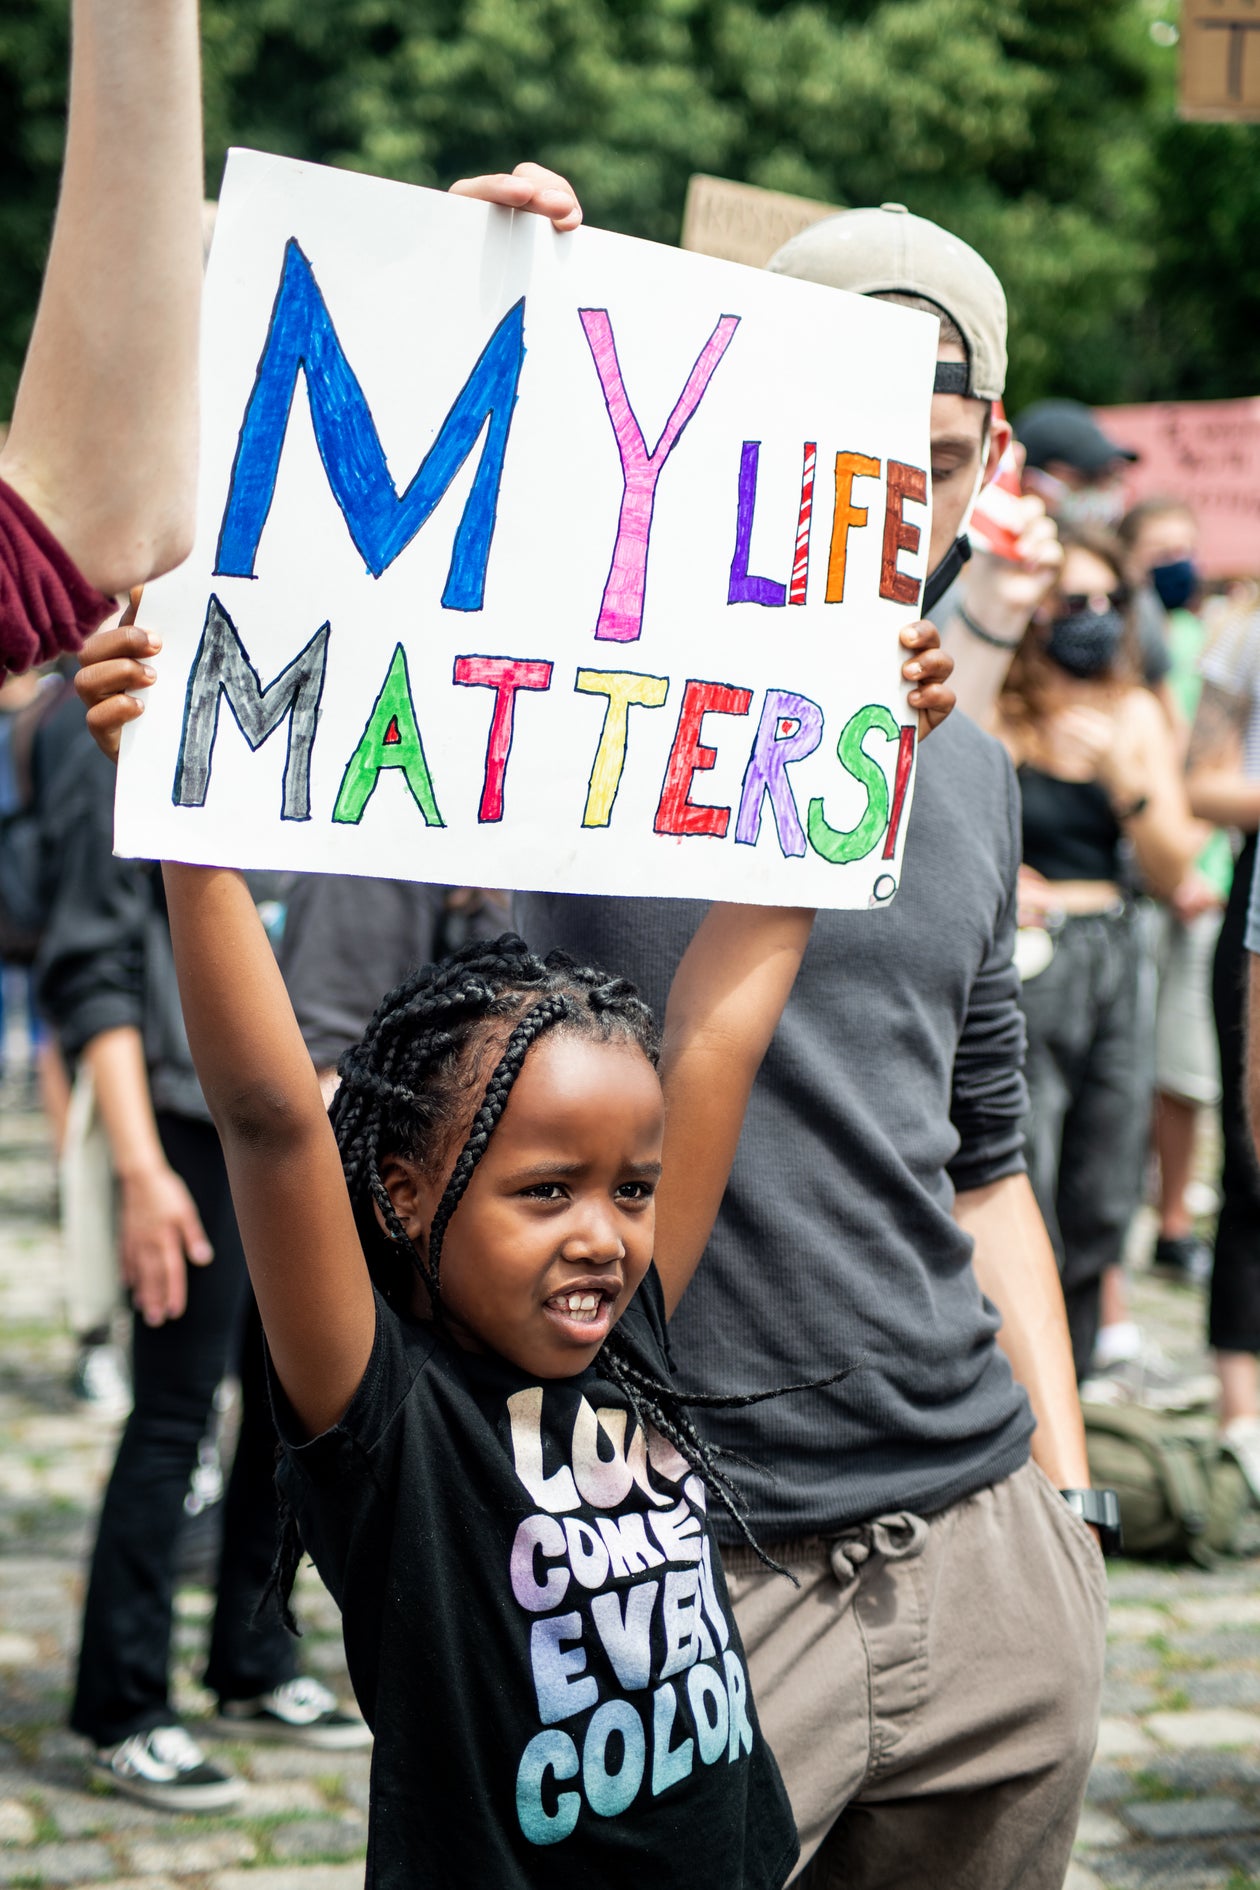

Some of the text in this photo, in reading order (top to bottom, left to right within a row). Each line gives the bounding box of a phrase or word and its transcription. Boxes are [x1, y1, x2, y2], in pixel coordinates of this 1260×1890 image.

[211, 236, 928, 642] MY LIFE
[172, 593, 918, 901] MATTERS!
[515, 1650, 753, 1845] COLOR
